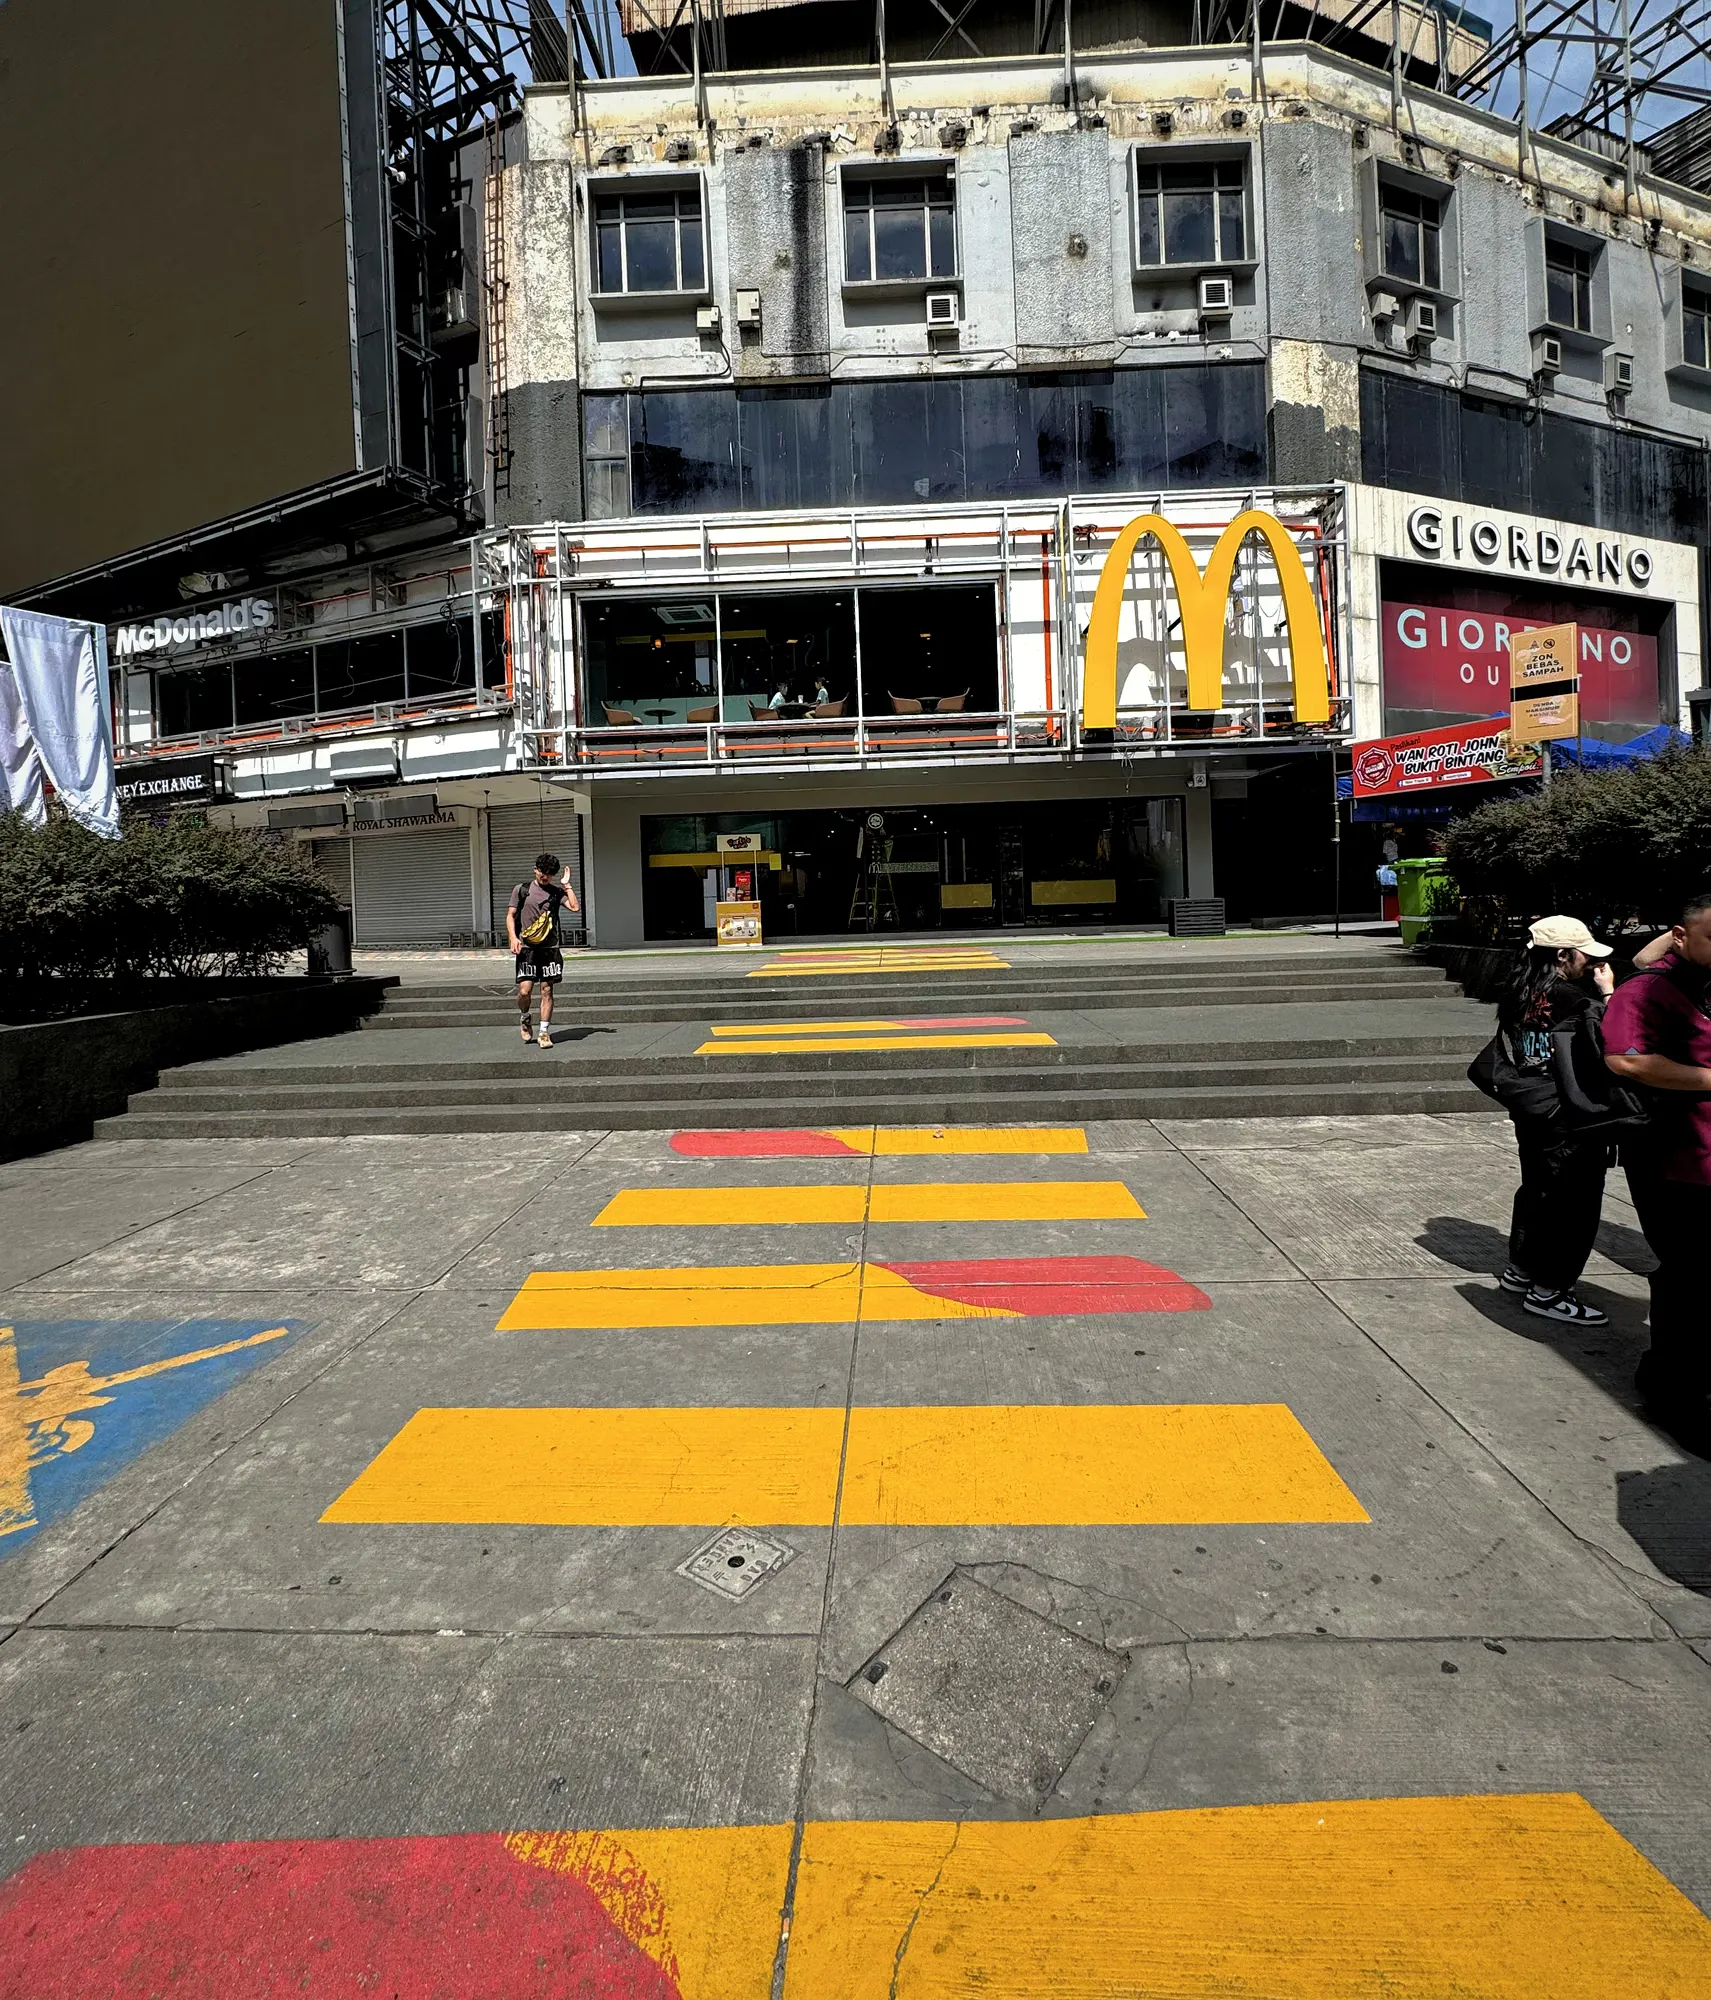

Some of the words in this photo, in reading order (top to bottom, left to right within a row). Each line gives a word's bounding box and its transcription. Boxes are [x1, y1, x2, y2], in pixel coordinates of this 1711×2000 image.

[1408, 506, 1653, 584] GIORDANO
[116, 597, 274, 655] McDonald's
[1397, 608, 1632, 665] GIORNO
[1526, 660, 1560, 670] BEBAS
[1532, 653, 1553, 662] ZON
[1522, 666, 1564, 678] SAMPAH
[1396, 747, 1423, 763] WAN
[1429, 743, 1458, 758] ROTI
[1463, 737, 1499, 753] JOHN
[1405, 760, 1440, 775] BUKIT
[1446, 750, 1504, 769] BINTANG
[116, 780, 139, 798] NEY
[139, 775, 203, 796] EXCHANGE
[353, 821, 385, 831] ROYAL
[387, 811, 456, 828] SHAWARMA
